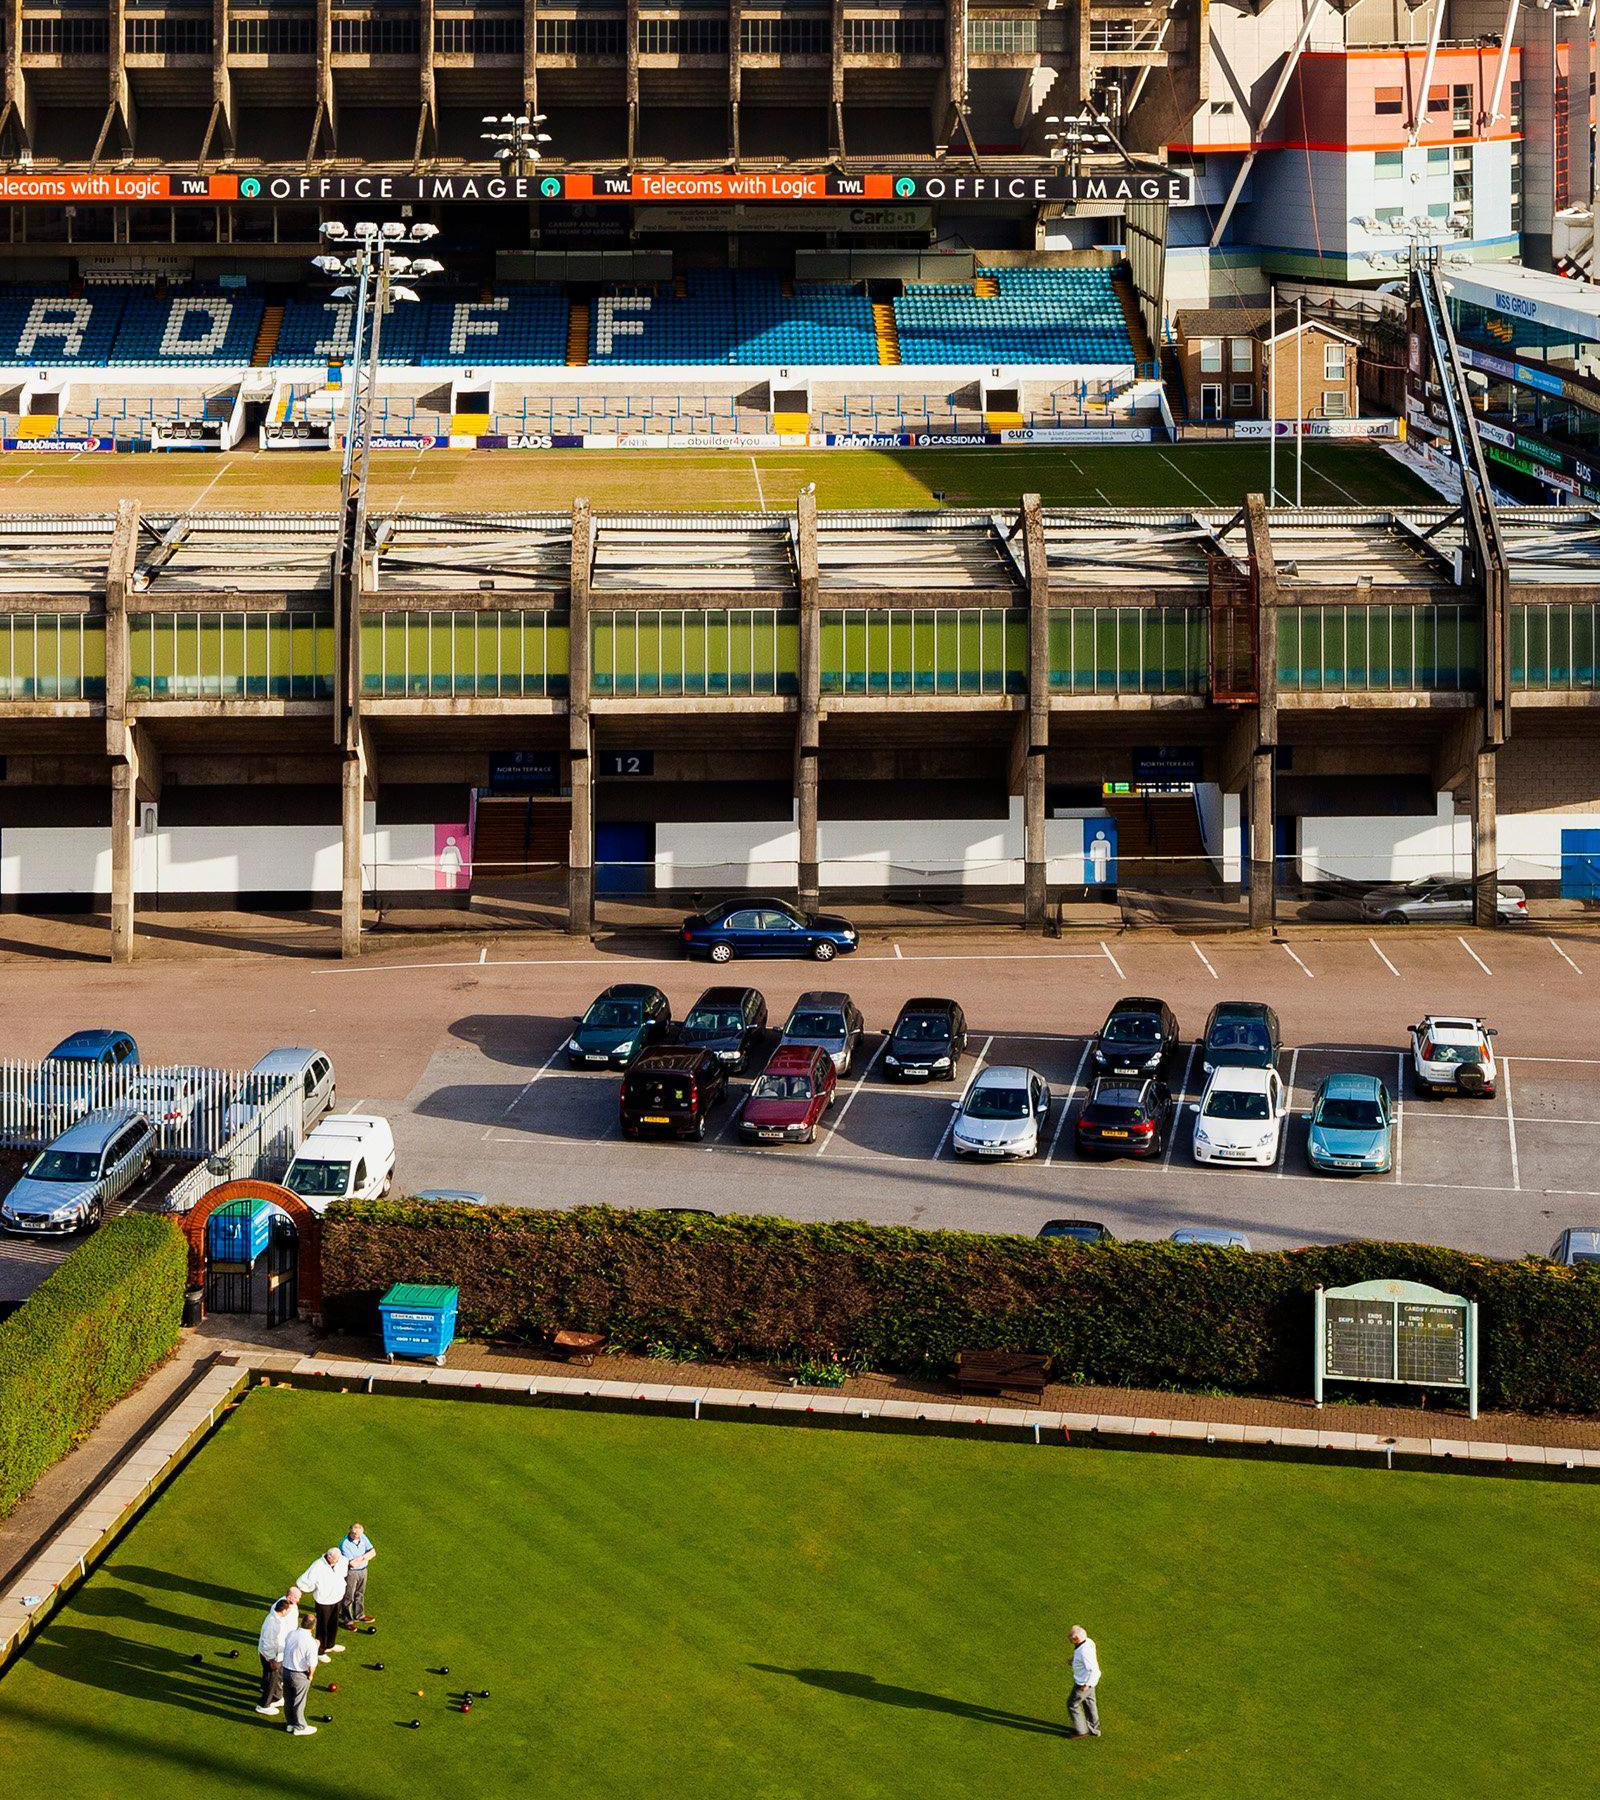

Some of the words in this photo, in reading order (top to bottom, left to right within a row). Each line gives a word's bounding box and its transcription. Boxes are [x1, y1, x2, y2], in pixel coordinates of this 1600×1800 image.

[71, 177, 110, 195] with
[116, 178, 160, 200] Logic
[181, 181, 208, 194] TWL
[270, 178, 393, 198] OFFICE
[418, 178, 528, 198] IMAGE
[604, 180, 631, 193] TWL
[641, 177, 723, 195] Telecoms
[728, 177, 767, 194] with
[773, 177, 816, 199] Logic
[837, 180, 864, 194] TWL
[925, 178, 1047, 198] OFFICE
[1072, 179, 1182, 200] IMAGE
[1495, 293, 1511, 311] MSS
[1511, 295, 1537, 317] GROUP
[833, 433, 901, 447] Rabobank
[931, 435, 986, 444] CASSIDIAN
[1008, 430, 1034, 438] euro
[16, 439, 66, 451] RaboDirect
[355, 437, 402, 450] RoDirect
[507, 435, 553, 448] EADS
[616, 757, 640, 772] 12
